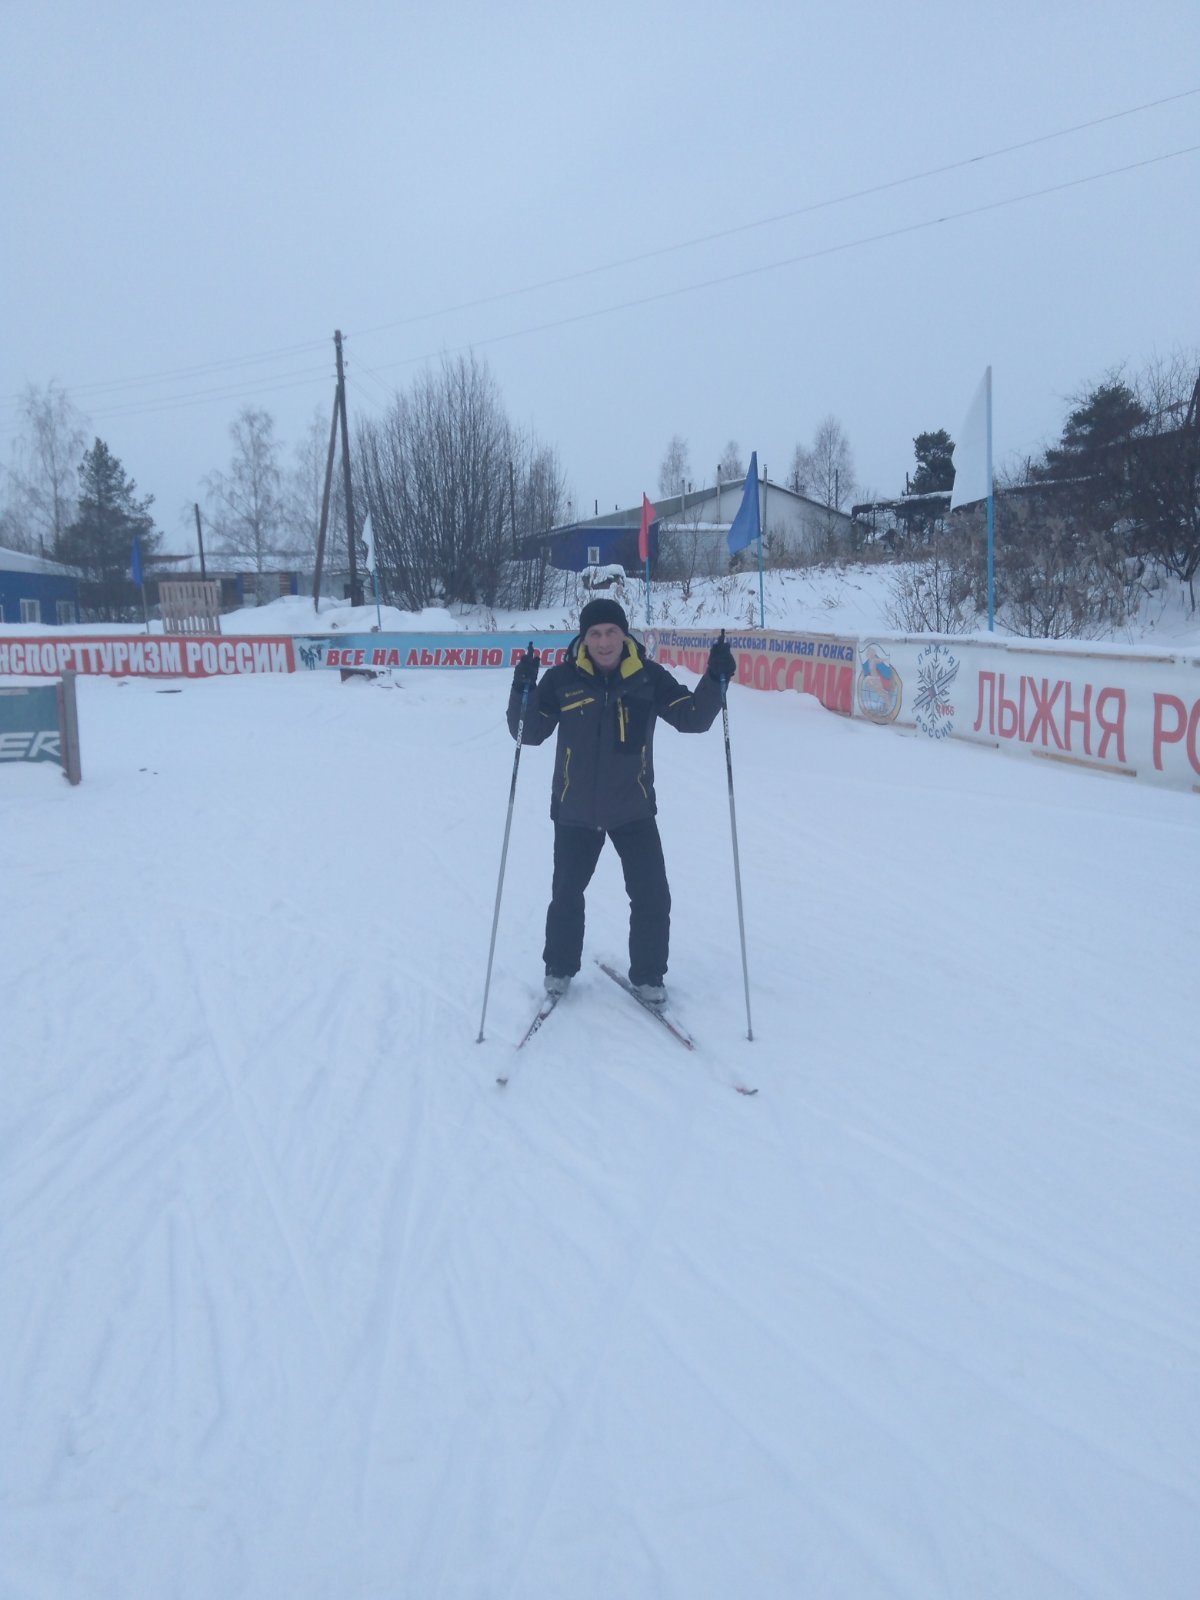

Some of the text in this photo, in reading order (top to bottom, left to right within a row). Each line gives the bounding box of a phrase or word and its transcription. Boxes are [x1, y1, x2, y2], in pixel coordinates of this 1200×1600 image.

[186, 642, 289, 674] РОССИИ
[326, 649, 365, 666] ВСЕ
[372, 648, 400, 666] НА
[406, 648, 503, 666] ЛЫЖНЮ
[672, 631, 719, 649] Всероссийск
[726, 637, 766, 650] массовая
[769, 640, 815, 656] лыжная
[817, 645, 854, 662] гонка
[974, 671, 1126, 763] ЛЫЖНЯ
